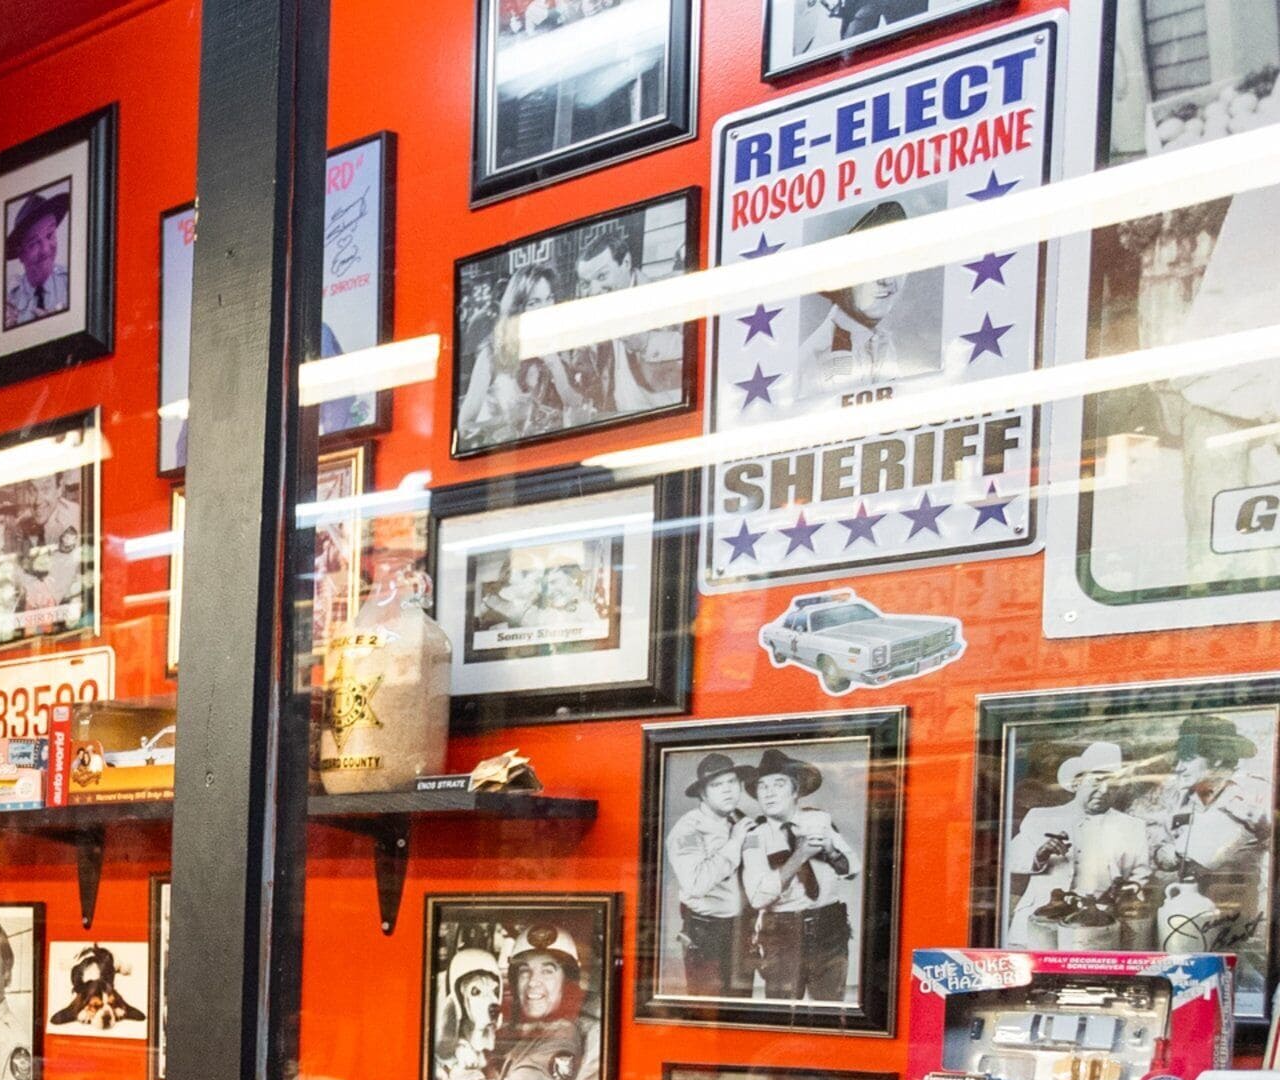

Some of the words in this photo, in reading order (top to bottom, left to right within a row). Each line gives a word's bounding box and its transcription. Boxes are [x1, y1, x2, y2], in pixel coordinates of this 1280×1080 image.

[734, 47, 1037, 184] RE-ELECT
[731, 168, 826, 231] ROSCO
[837, 159, 862, 202] P.
[874, 108, 1035, 189] COLTRANE
[724, 416, 1021, 513] SHERIFF
[497, 632, 533, 642] Sonny
[53, 732, 66, 772] world
[343, 756, 381, 769] COUNTY
[53, 774, 66, 804] auto
[417, 781, 436, 791] ENOS
[923, 960, 958, 979] THE
